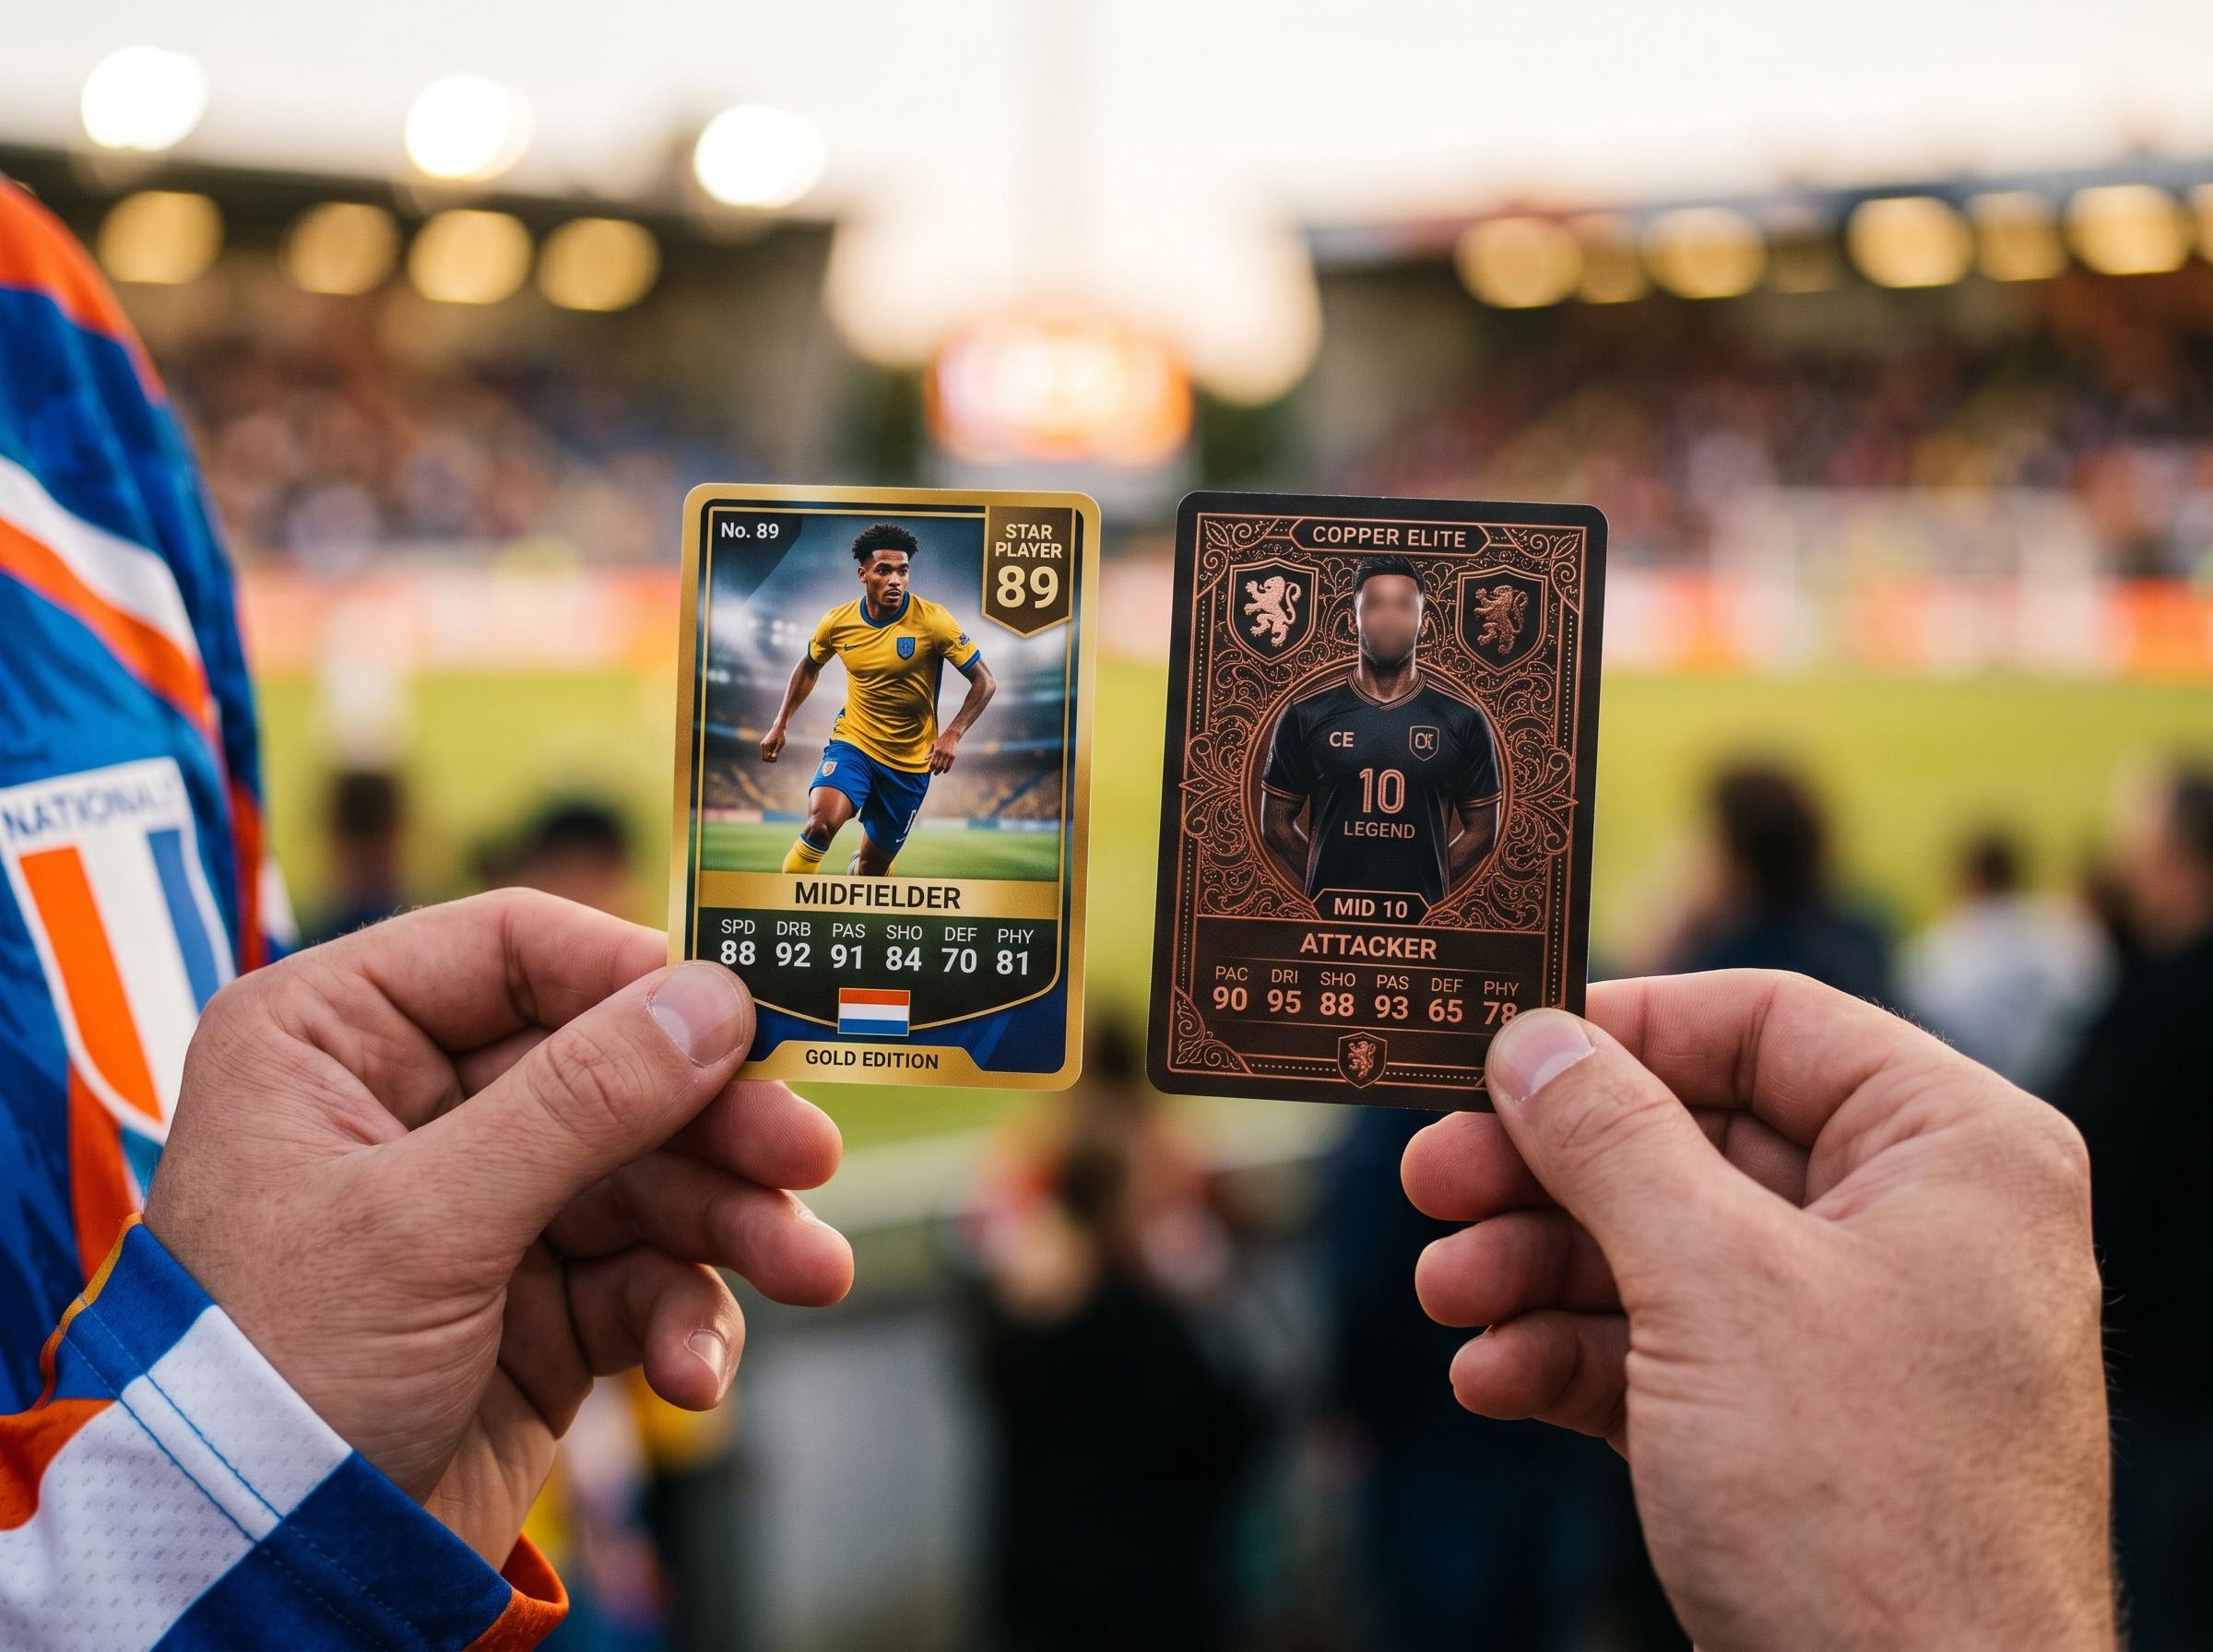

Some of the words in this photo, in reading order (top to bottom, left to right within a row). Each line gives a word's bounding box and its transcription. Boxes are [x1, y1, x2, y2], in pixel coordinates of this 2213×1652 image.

[722, 523, 750, 537] No.
[757, 524, 778, 538] 89
[1006, 524, 1052, 539] STAR
[1313, 526, 1399, 545] COPPER
[1408, 530, 1465, 547] ELITE
[996, 542, 1061, 558] PLAYER
[997, 565, 1058, 608] 89
[1330, 732, 1354, 747] CE
[1359, 769, 1404, 813] 10
[1344, 821, 1414, 838] LEGEND
[796, 882, 960, 909] MIDFIELDER
[1335, 898, 1375, 915] MID
[1384, 901, 1407, 918] 10
[722, 919, 755, 934] SPD
[777, 921, 811, 936] DRB
[833, 923, 865, 938] PAS
[887, 925, 922, 939] SHO
[945, 927, 977, 941] DEF
[999, 929, 1034, 943] PHY
[721, 940, 755, 965] 88
[776, 942, 811, 967] 92
[831, 944, 861, 969] 91
[886, 946, 921, 971] 84
[941, 949, 976, 973] 70
[997, 950, 1027, 974] 81
[1300, 933, 1436, 959] ATTACKER
[1216, 966, 1248, 981] PAC
[1272, 969, 1297, 983] DRI
[1320, 972, 1355, 986] SHO
[1378, 975, 1409, 989] PAS
[1432, 978, 1463, 992] DEF
[1485, 981, 1519, 996] PHY
[1213, 986, 1247, 1010] 90
[1268, 989, 1301, 1013] 95
[1320, 992, 1354, 1016] 88
[1375, 996, 1408, 1019] 93
[1429, 999, 1462, 1022] 65
[1484, 1001, 1518, 1025] 78
[806, 1049, 856, 1066] GOLD
[863, 1052, 938, 1069] EDITION
